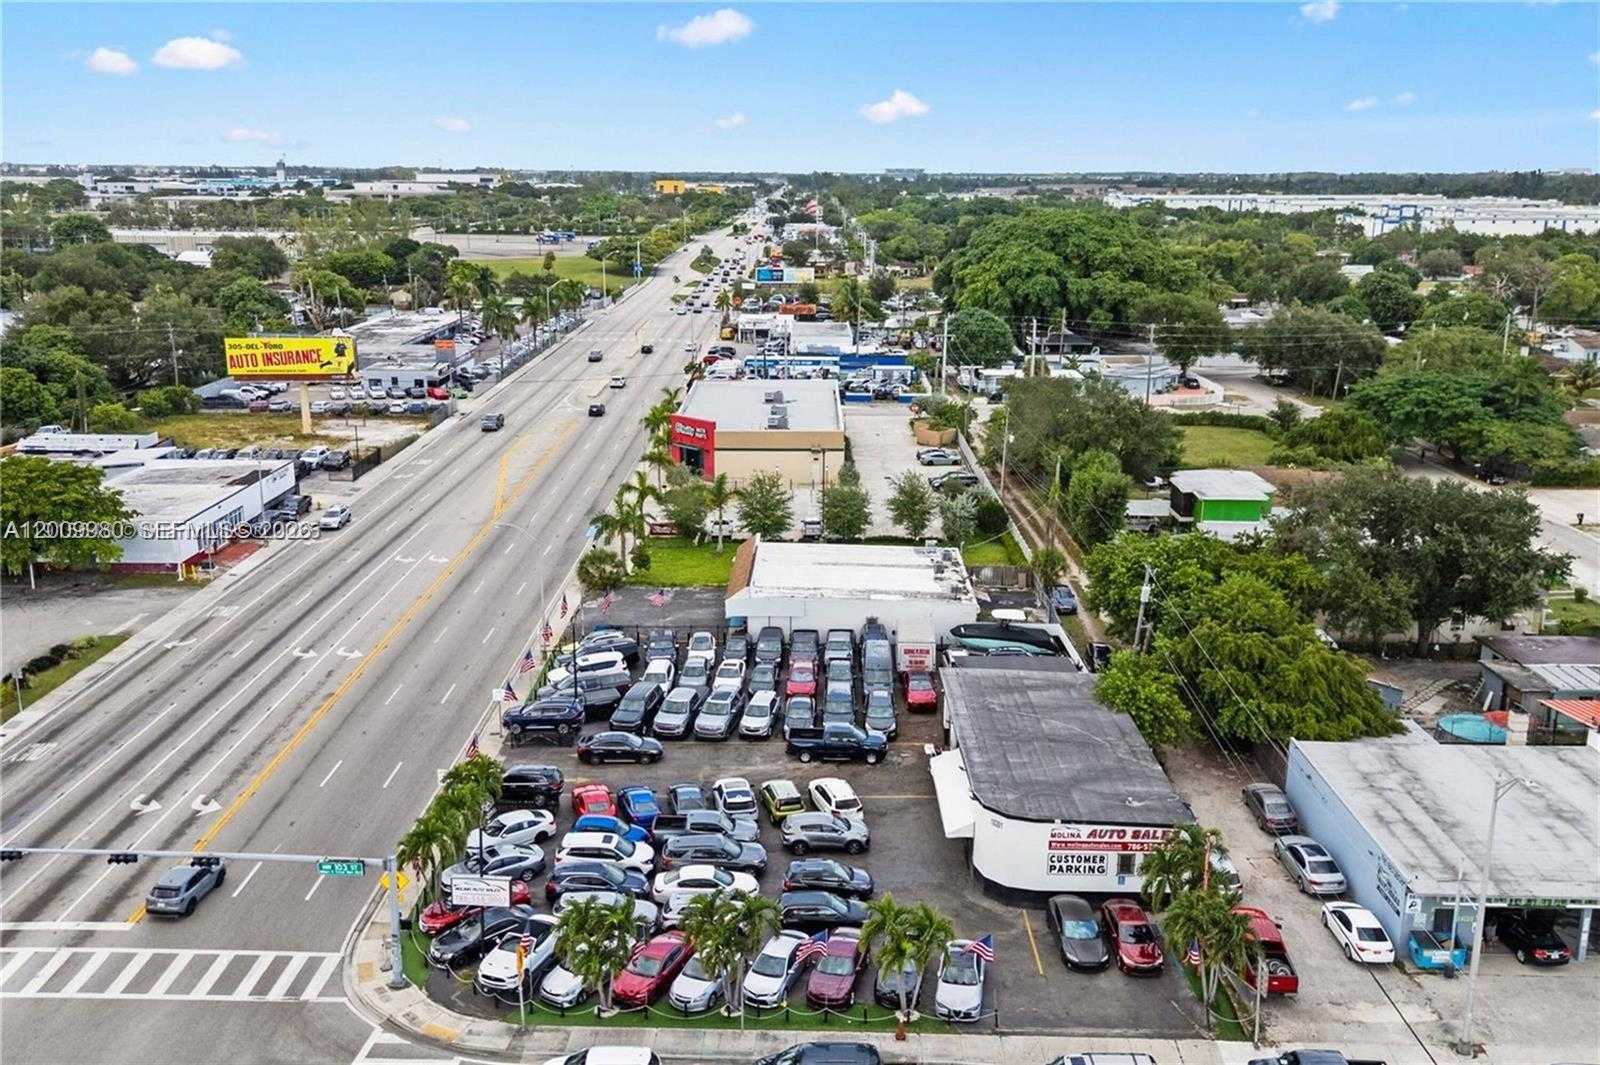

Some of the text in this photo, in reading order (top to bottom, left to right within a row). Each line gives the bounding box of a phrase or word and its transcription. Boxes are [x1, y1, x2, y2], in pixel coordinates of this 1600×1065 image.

[229, 348, 323, 369] AUTO INSURANCE
[1087, 828, 1127, 840] AUTO
[1049, 855, 1106, 864] CUSTOMER
[1049, 865, 1106, 874] PARKING
